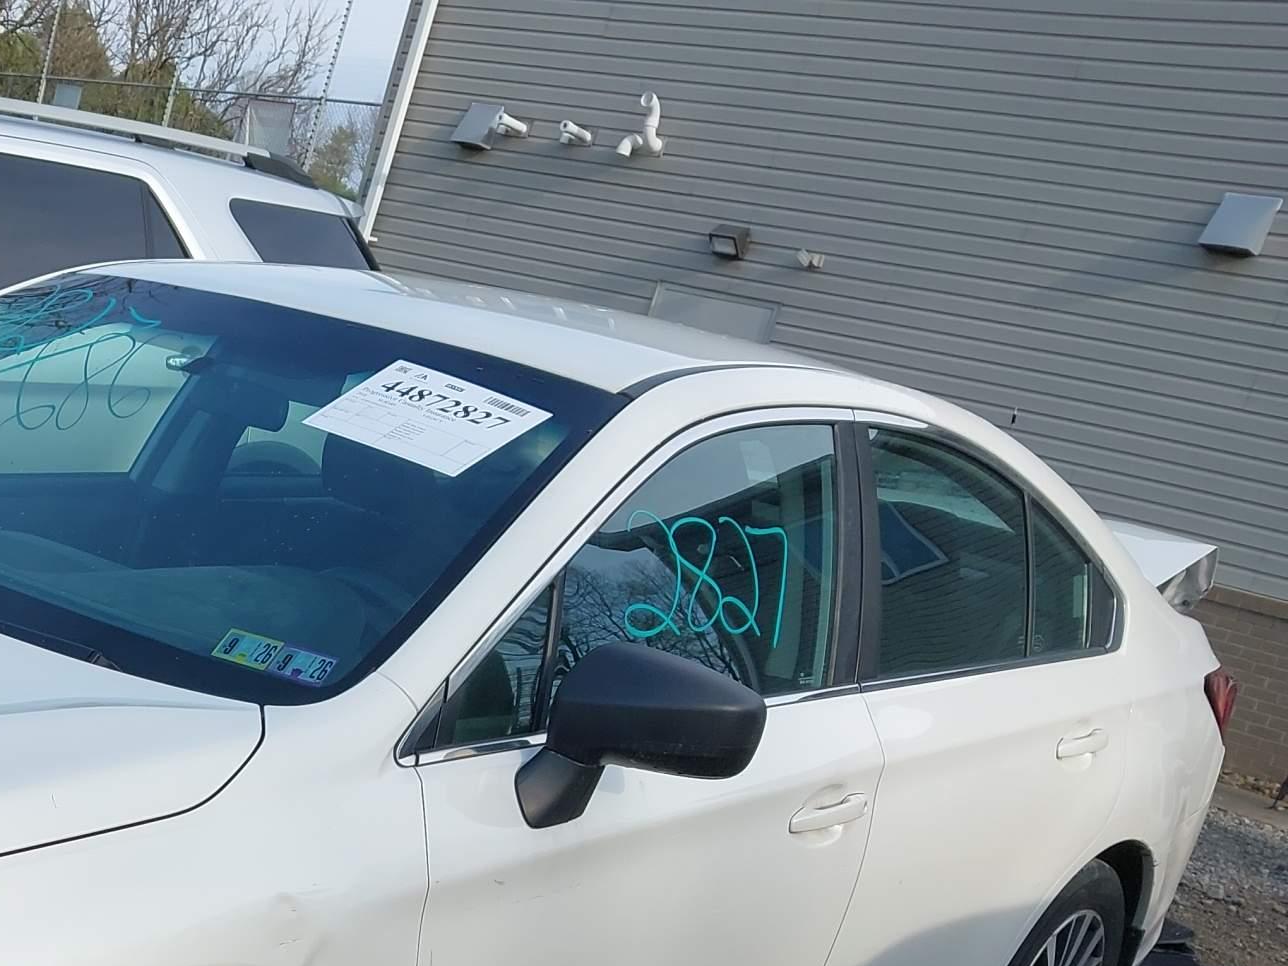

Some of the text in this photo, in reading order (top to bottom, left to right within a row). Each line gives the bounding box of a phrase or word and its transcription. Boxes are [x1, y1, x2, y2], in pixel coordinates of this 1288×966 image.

[381, 380, 510, 429] 44872827
[624, 509, 789, 649] 2827
[254, 643, 278, 665] 26
[309, 658, 334, 681] 26
